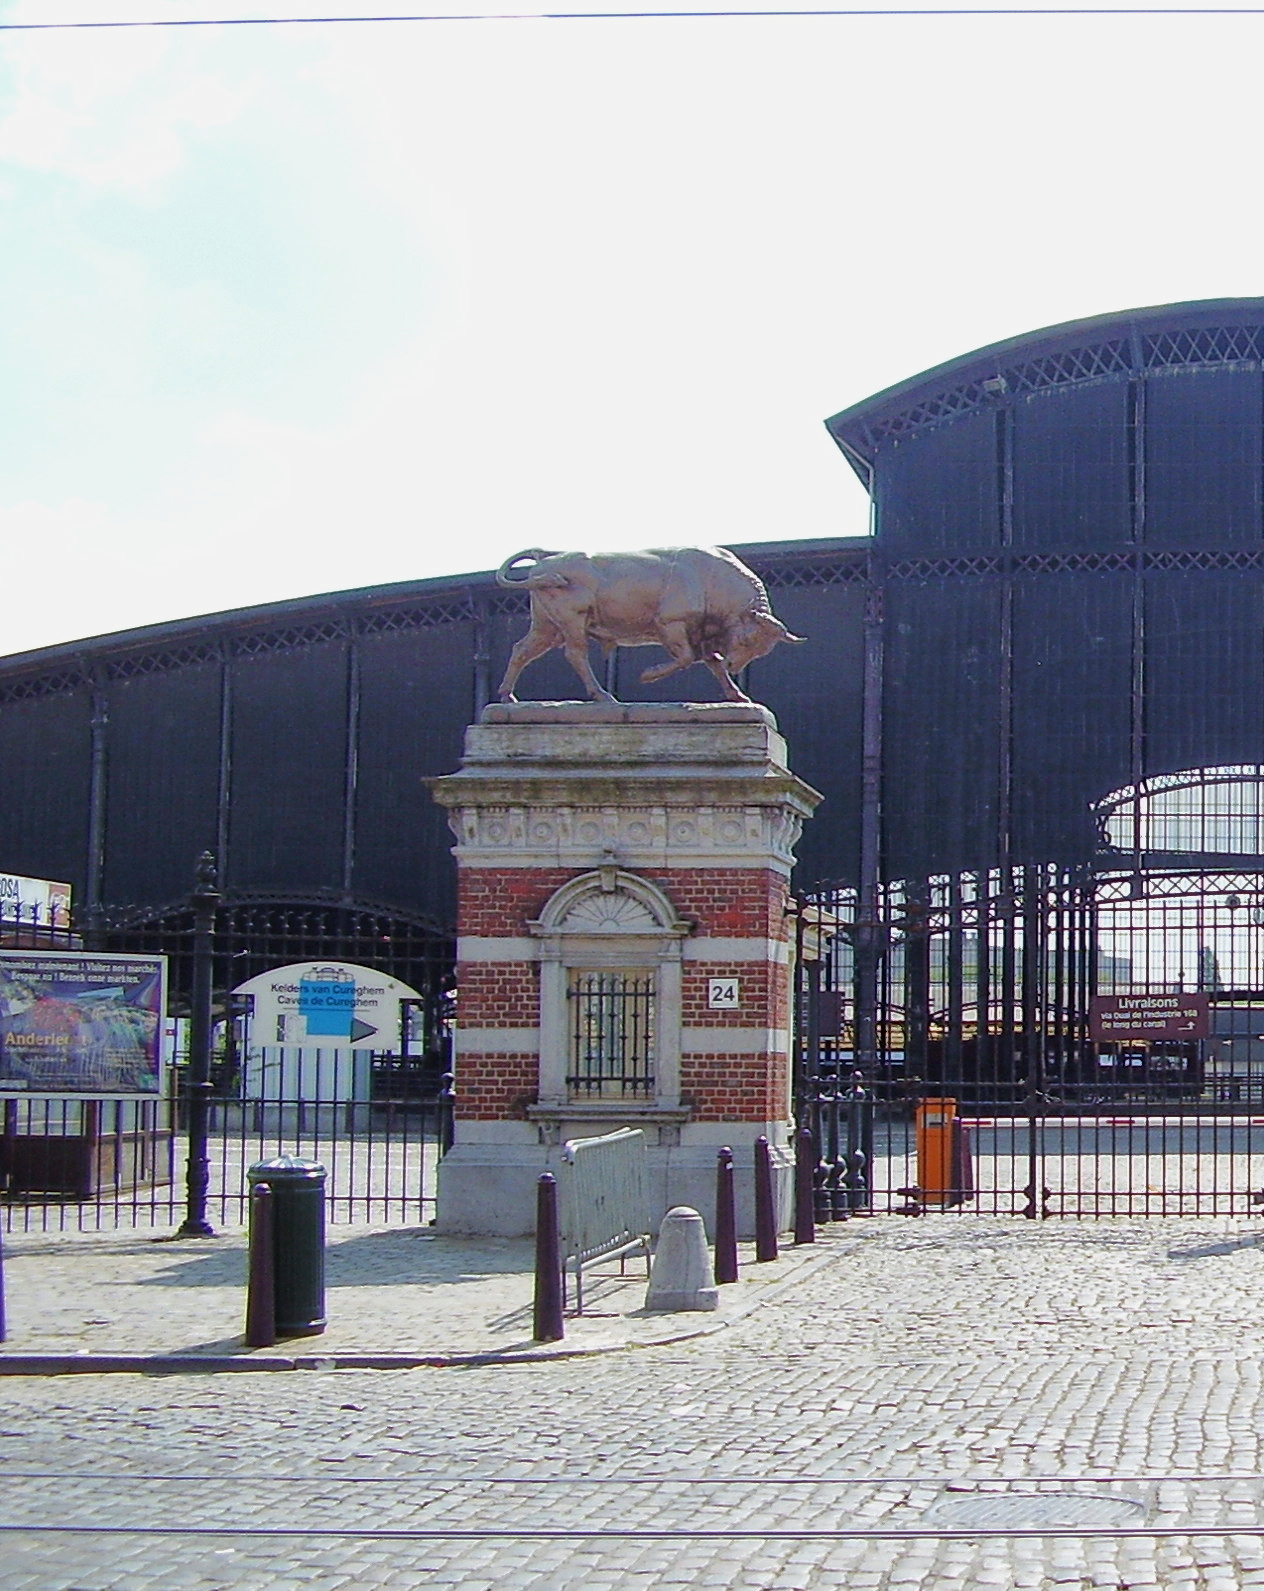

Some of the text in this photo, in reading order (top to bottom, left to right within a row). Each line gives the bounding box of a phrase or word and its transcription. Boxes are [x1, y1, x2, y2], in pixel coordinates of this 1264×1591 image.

[271, 983, 385, 997] Kelders van Cureghem
[712, 985, 735, 1001] 24
[277, 995, 378, 1008] Caves de Cureghem
[1118, 997, 1179, 1009] Livraisons
[1132, 1010, 1142, 1018] de
[1131, 1020, 1142, 1028] du
